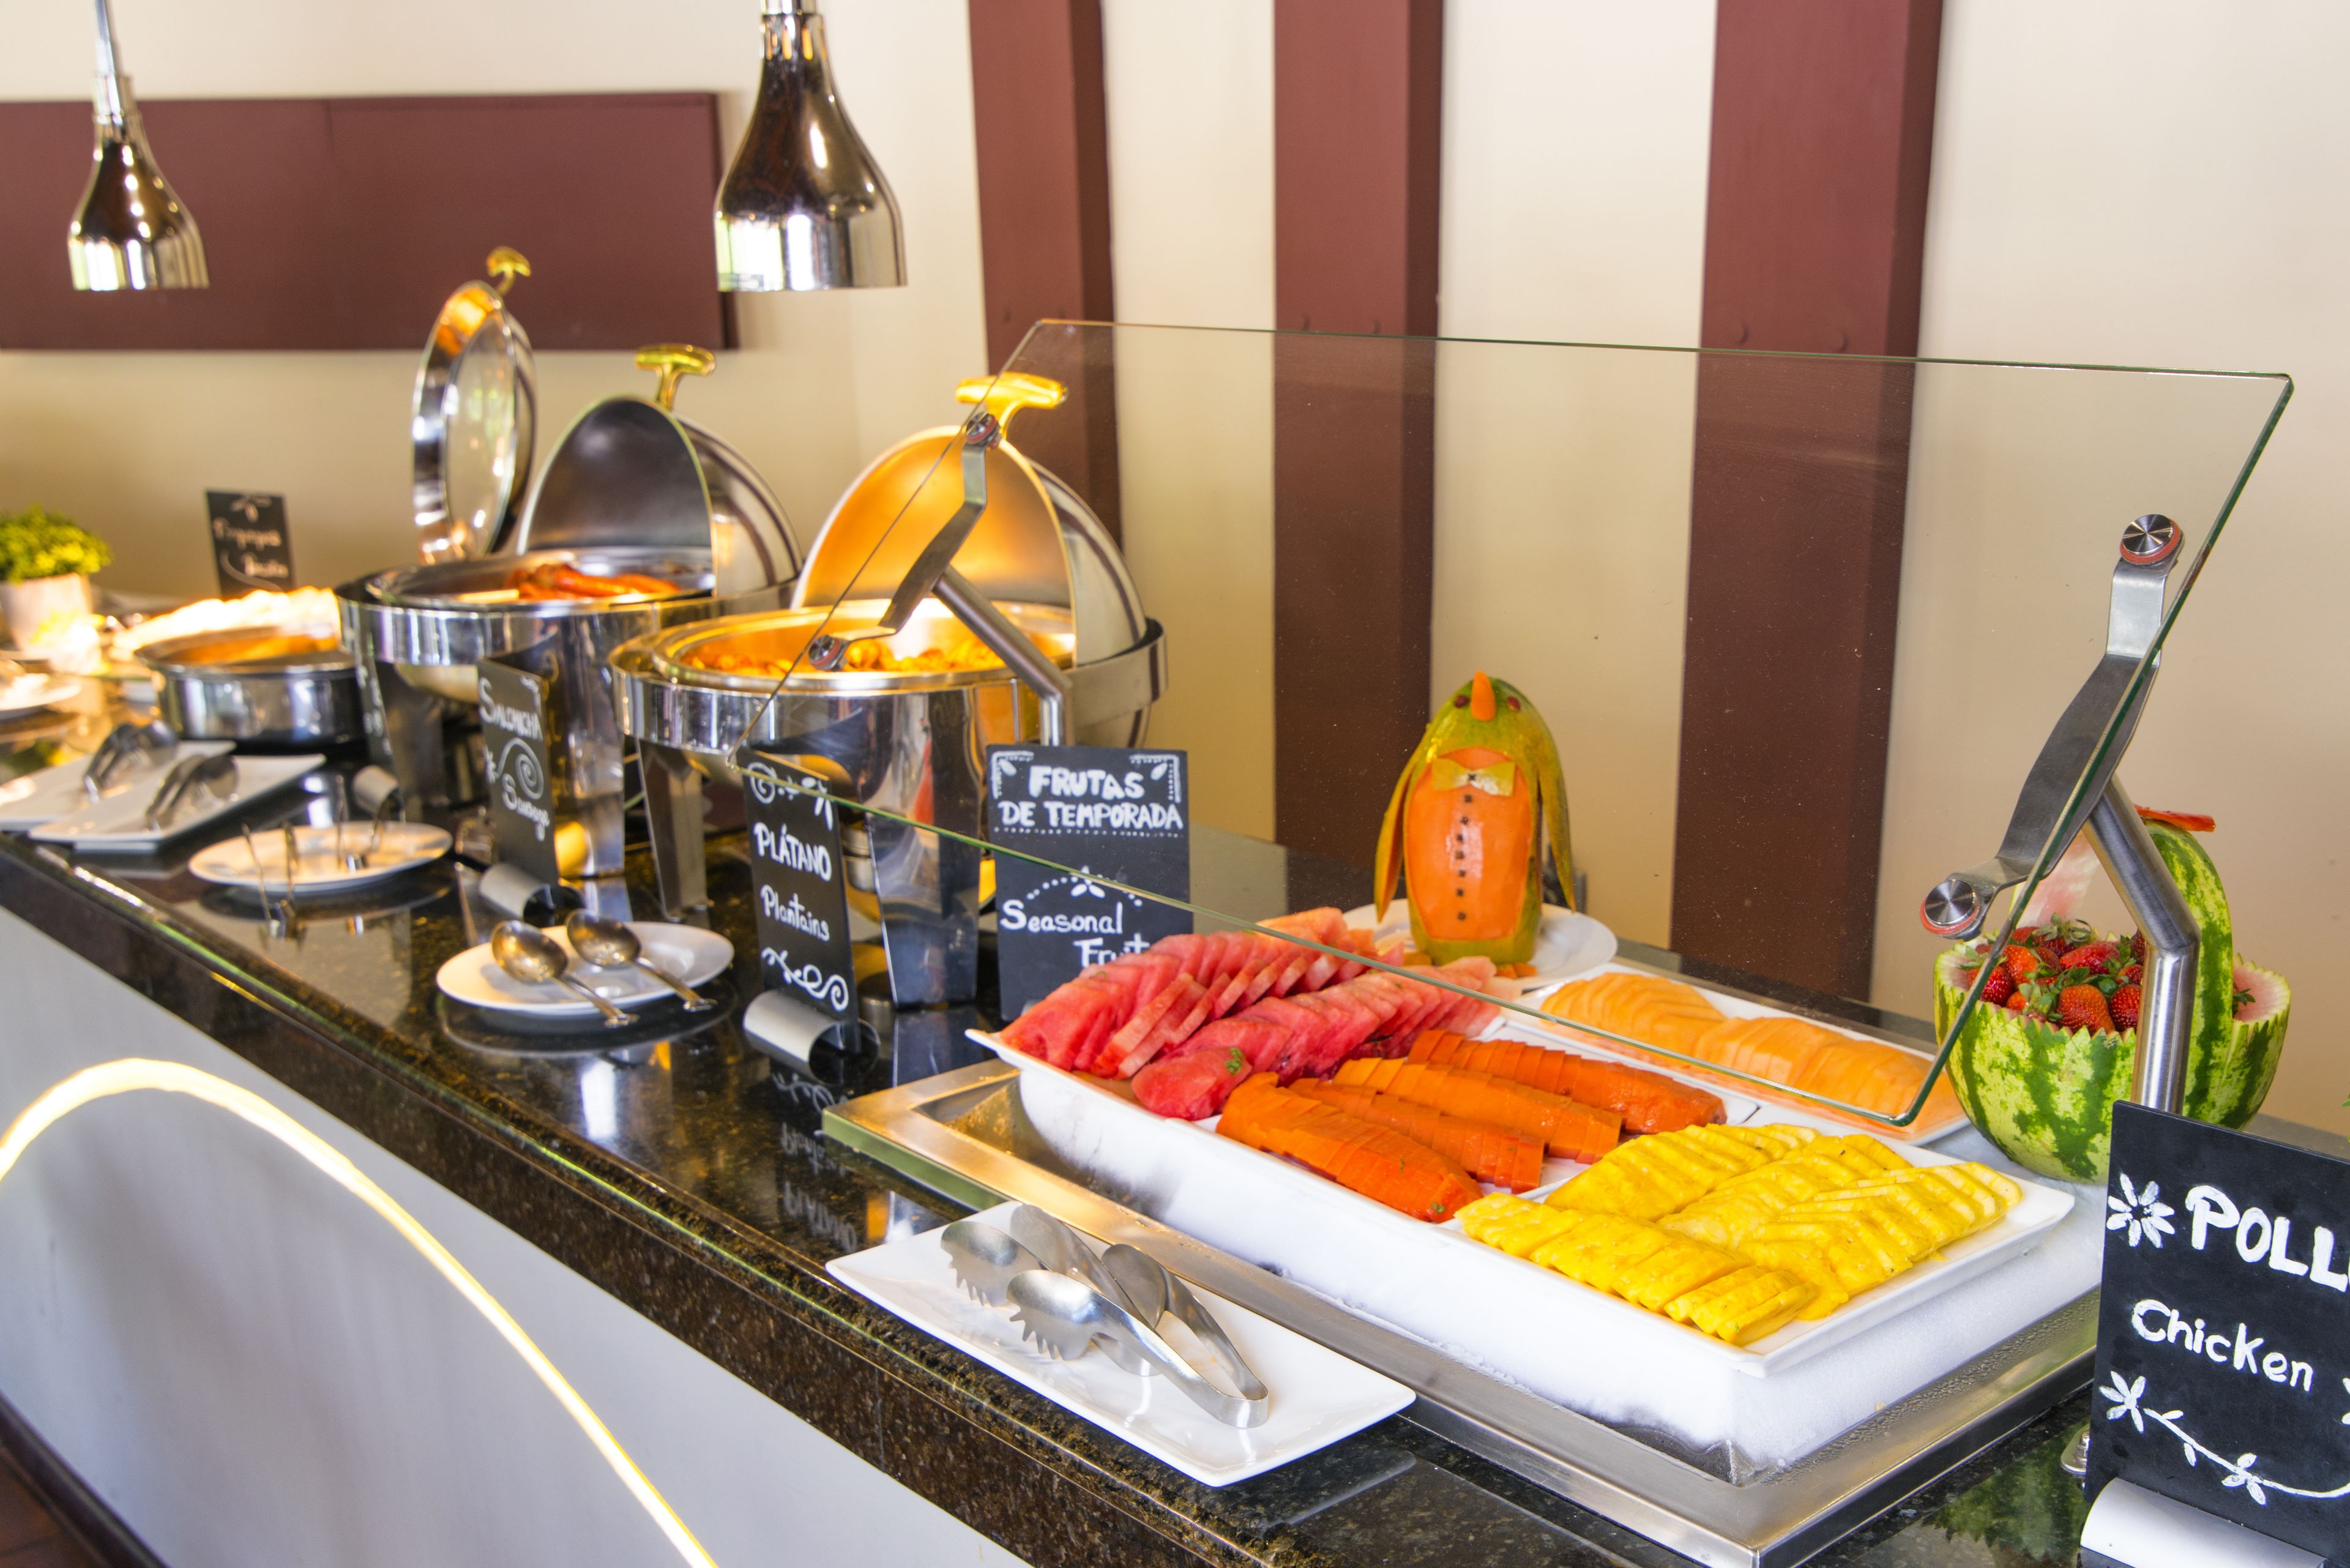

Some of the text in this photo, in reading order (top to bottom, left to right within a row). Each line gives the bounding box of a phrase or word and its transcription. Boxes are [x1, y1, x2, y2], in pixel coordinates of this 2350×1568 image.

[1028, 764, 1146, 801] FRUTAS
[997, 800, 1184, 830] DE TEMPORADA
[753, 821, 833, 882] PLÁTANO
[760, 884, 830, 942] Plantains
[999, 898, 1124, 935] Seasonal
[1073, 932, 1151, 968] Frt
[2184, 1185, 2350, 1293] POLL
[2131, 1298, 2314, 1392] Chicken
